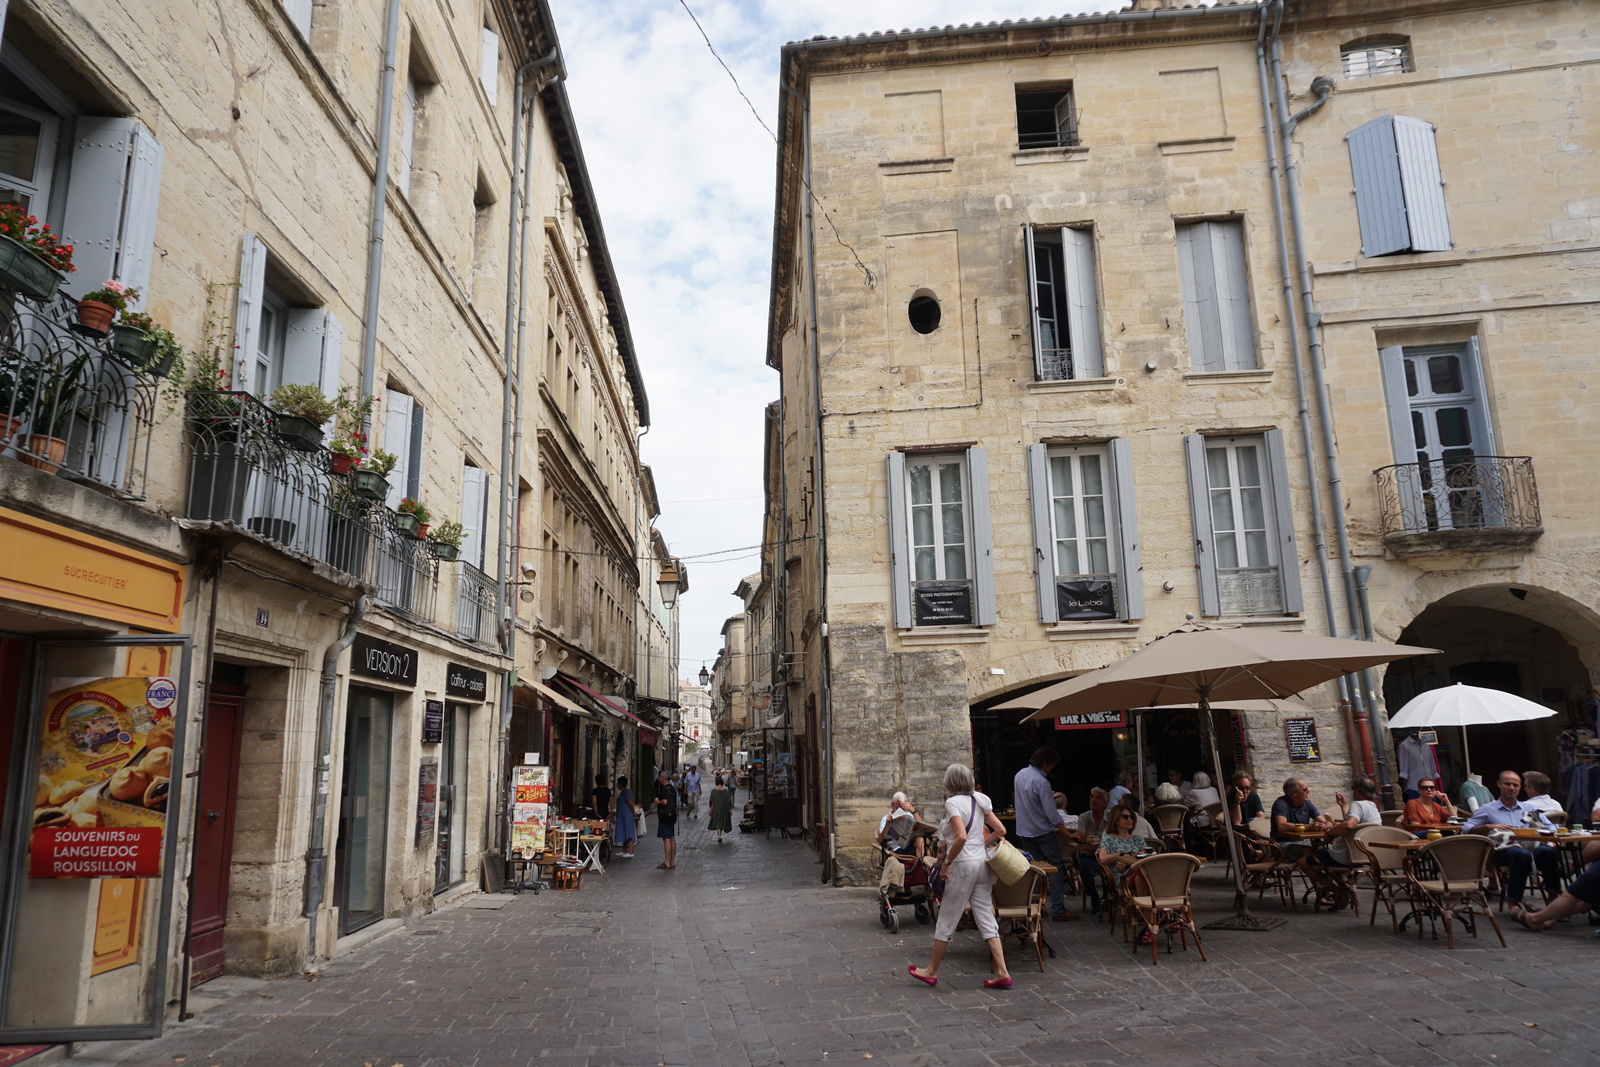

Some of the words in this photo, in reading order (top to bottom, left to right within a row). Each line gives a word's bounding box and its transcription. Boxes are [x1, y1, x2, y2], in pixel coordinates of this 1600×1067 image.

[1078, 599, 1103, 607] Labo
[365, 647, 402, 677] VERSION
[402, 653, 410, 679] 2
[146, 690, 177, 698] FRANCE
[1060, 715, 1079, 725] BAR
[1087, 712, 1105, 723] VINS
[54, 831, 126, 842] SOUVENIRS
[126, 833, 141, 842] DU
[53, 845, 139, 858] LANGUEDOC
[53, 860, 137, 873] ROUSSILLON
